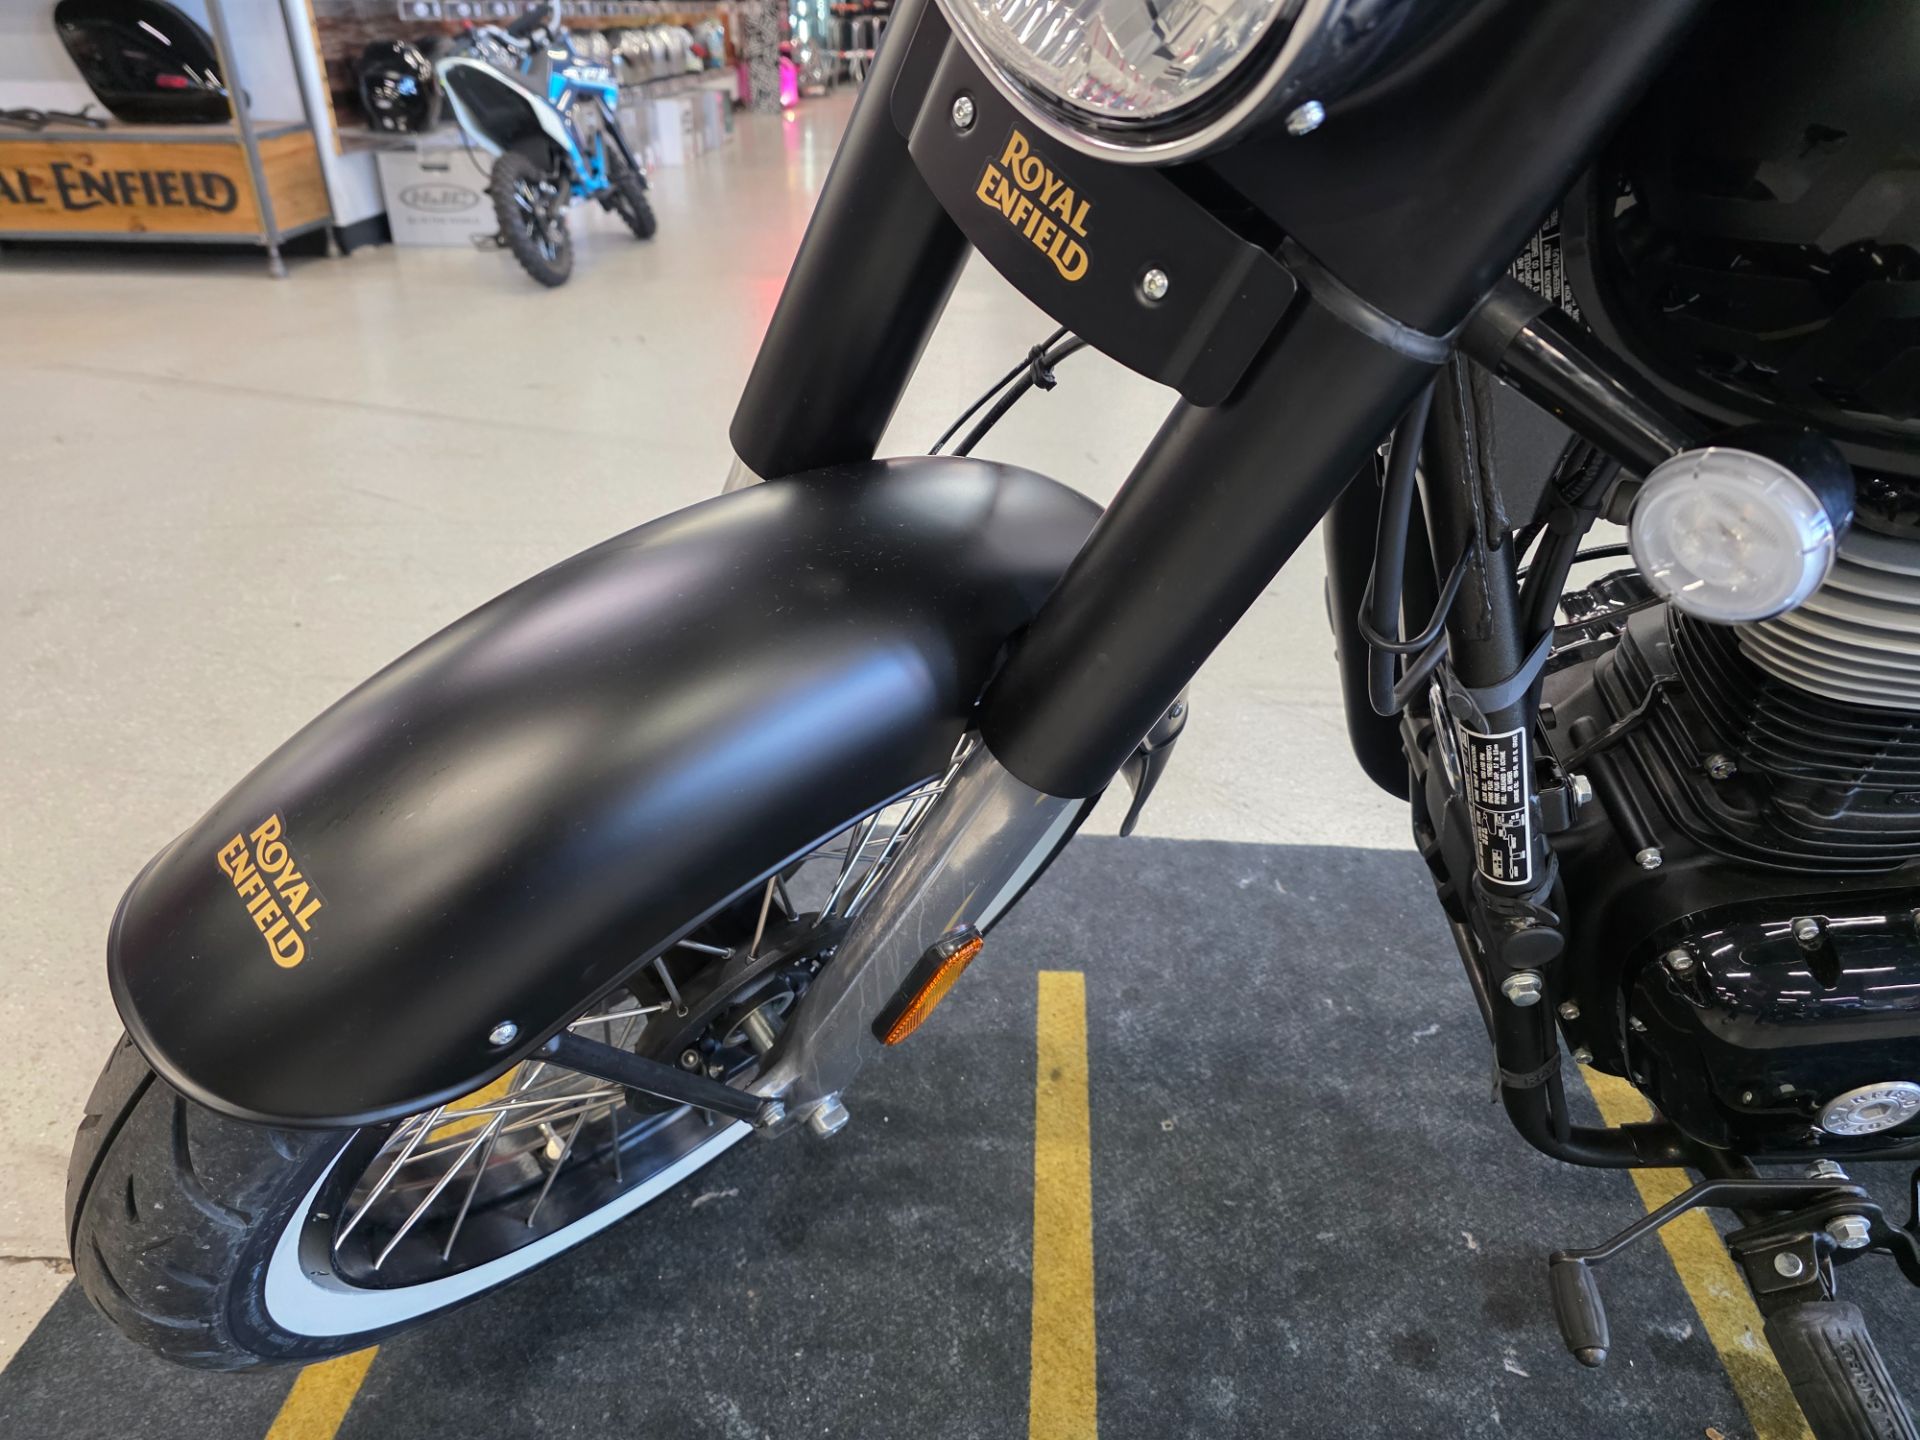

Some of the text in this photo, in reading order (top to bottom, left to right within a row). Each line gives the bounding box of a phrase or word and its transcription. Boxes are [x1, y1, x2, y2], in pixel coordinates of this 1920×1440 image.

[51, 162, 238, 213] ENFIELD
[976, 163, 1089, 282] ENFIELD
[1000, 129, 1091, 238] ROYAL
[217, 833, 305, 968] ENFIELD
[250, 814, 322, 932] ROYAL
